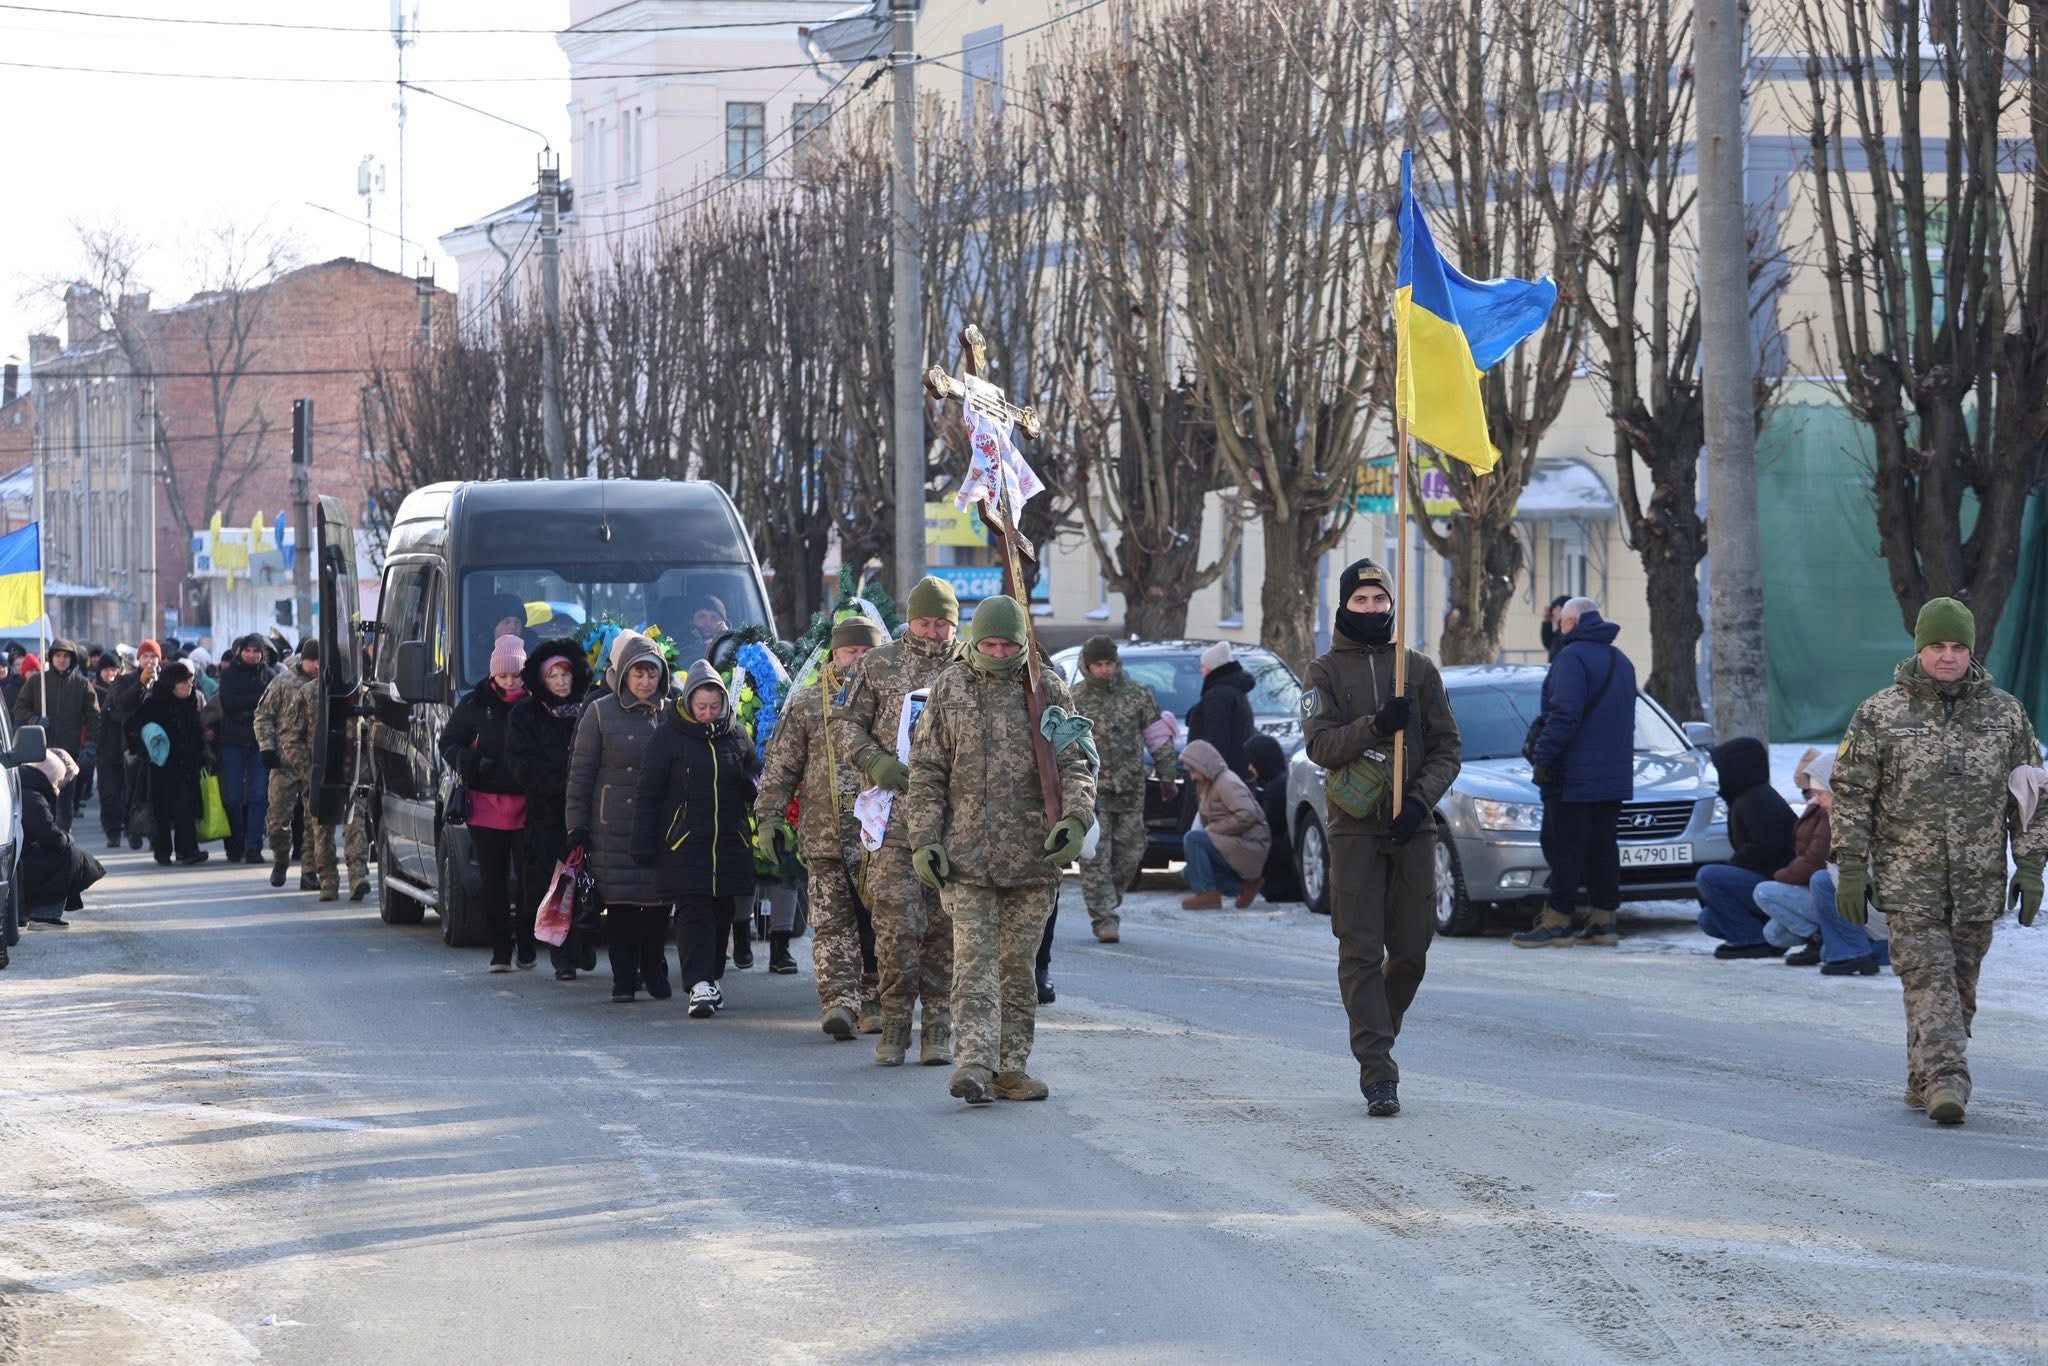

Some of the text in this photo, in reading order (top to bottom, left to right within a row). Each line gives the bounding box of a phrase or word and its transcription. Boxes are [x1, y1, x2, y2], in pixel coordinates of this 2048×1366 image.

[1621, 846, 1688, 863] A 4790 IE
